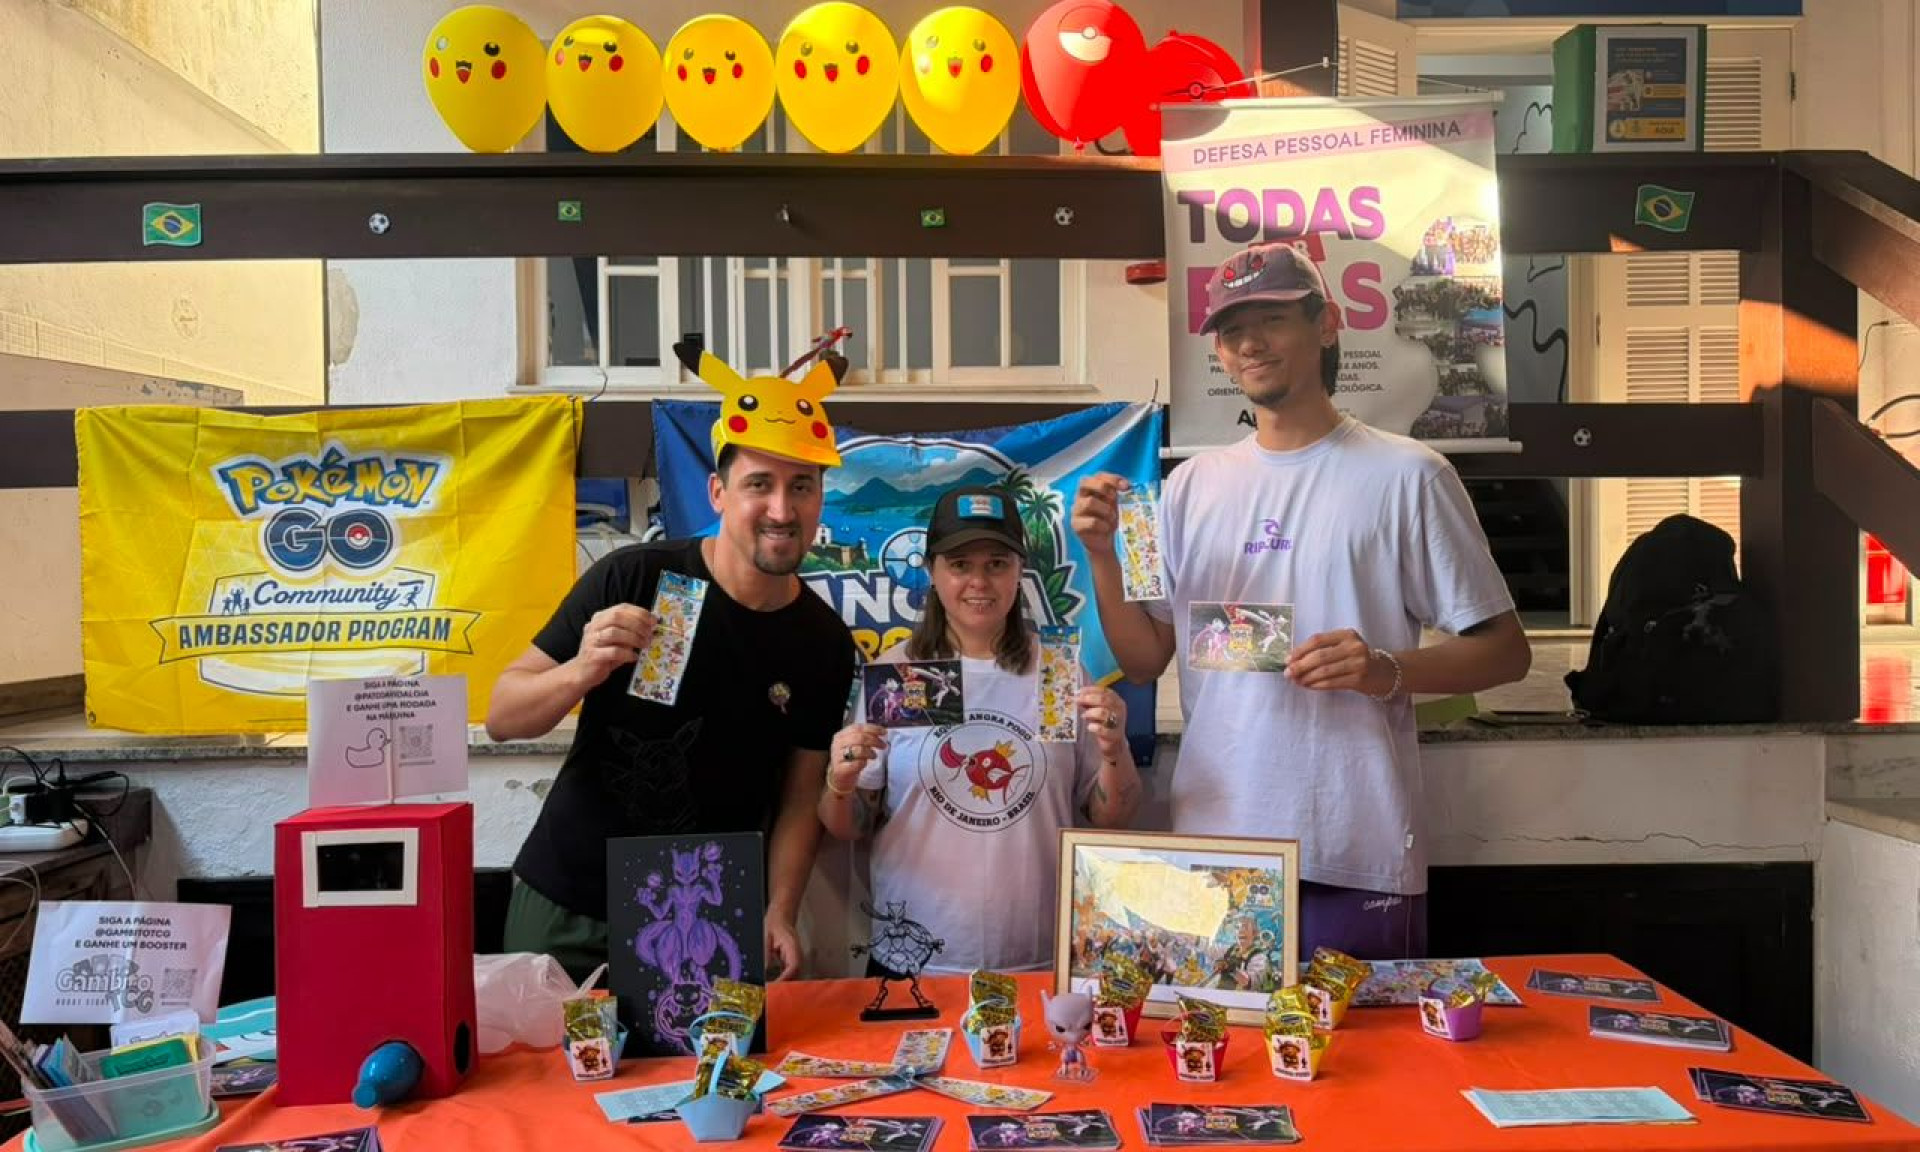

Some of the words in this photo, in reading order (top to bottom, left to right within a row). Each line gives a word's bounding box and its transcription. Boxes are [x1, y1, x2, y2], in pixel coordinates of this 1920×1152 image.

[1193, 142, 1268, 165] DEFESA
[1274, 131, 1364, 156] PESSOAL
[1370, 119, 1462, 145] FEMININA
[1176, 185, 1386, 244] TODAS
[263, 507, 393, 571] GO
[252, 579, 402, 611] Community
[178, 620, 342, 650] AMBASSADOR
[347, 616, 452, 643] PROGRAM
[968, 713, 1005, 726] ANGRA
[1006, 720, 1033, 742] POGO
[928, 785, 946, 803] RIO
[942, 801, 959, 817] DE
[956, 814, 1001, 827] JANEIRO
[1006, 790, 1037, 819] BRASIL
[98, 915, 124, 925] SIGA
[125, 916, 133, 925] A
[133, 915, 171, 927] PÁGINA
[75, 941, 81, 949] E
[83, 940, 120, 950] GANHE
[122, 940, 138, 949] UM
[138, 940, 188, 951] BOOSTER
